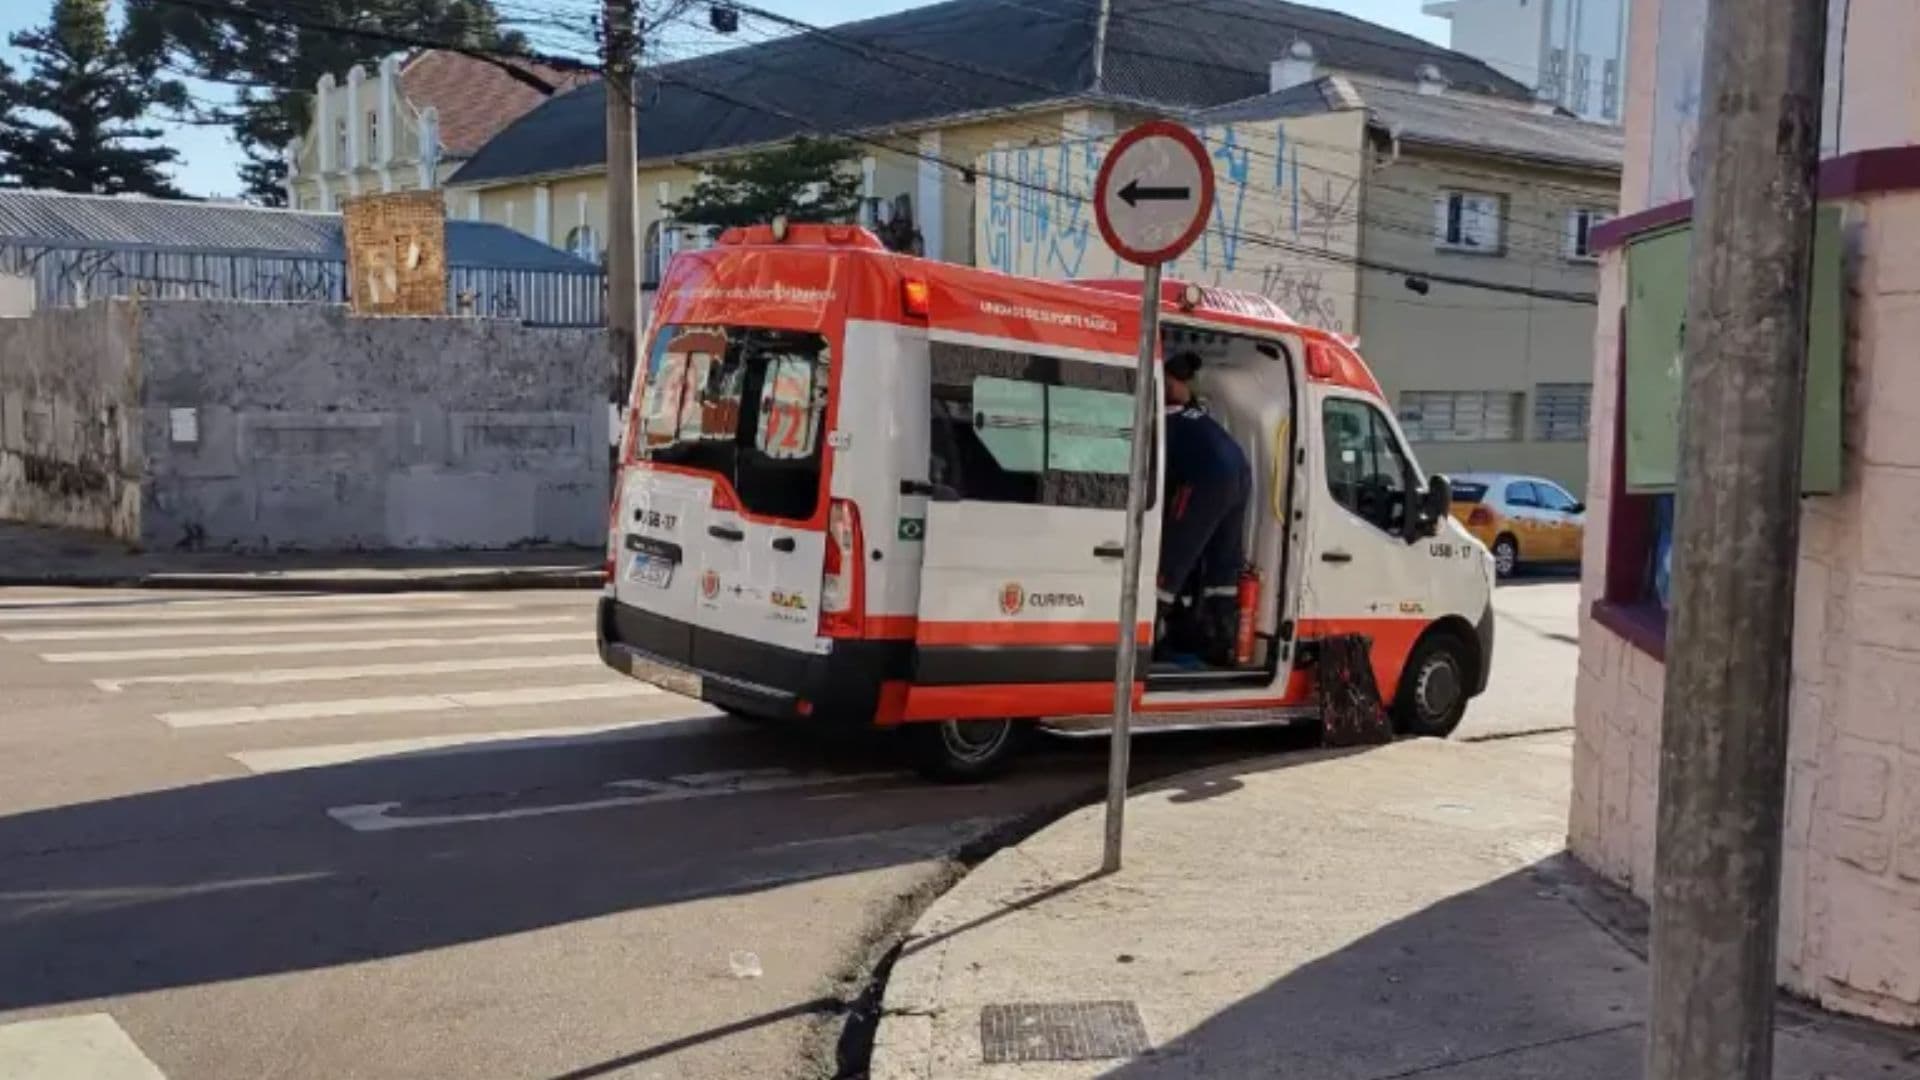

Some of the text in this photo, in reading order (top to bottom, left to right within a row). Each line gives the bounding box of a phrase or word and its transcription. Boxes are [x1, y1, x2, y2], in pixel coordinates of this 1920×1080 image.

[1429, 543, 1452, 558] USB
[1461, 545, 1472, 559] 17
[1029, 593, 1085, 607] CURITIBA
